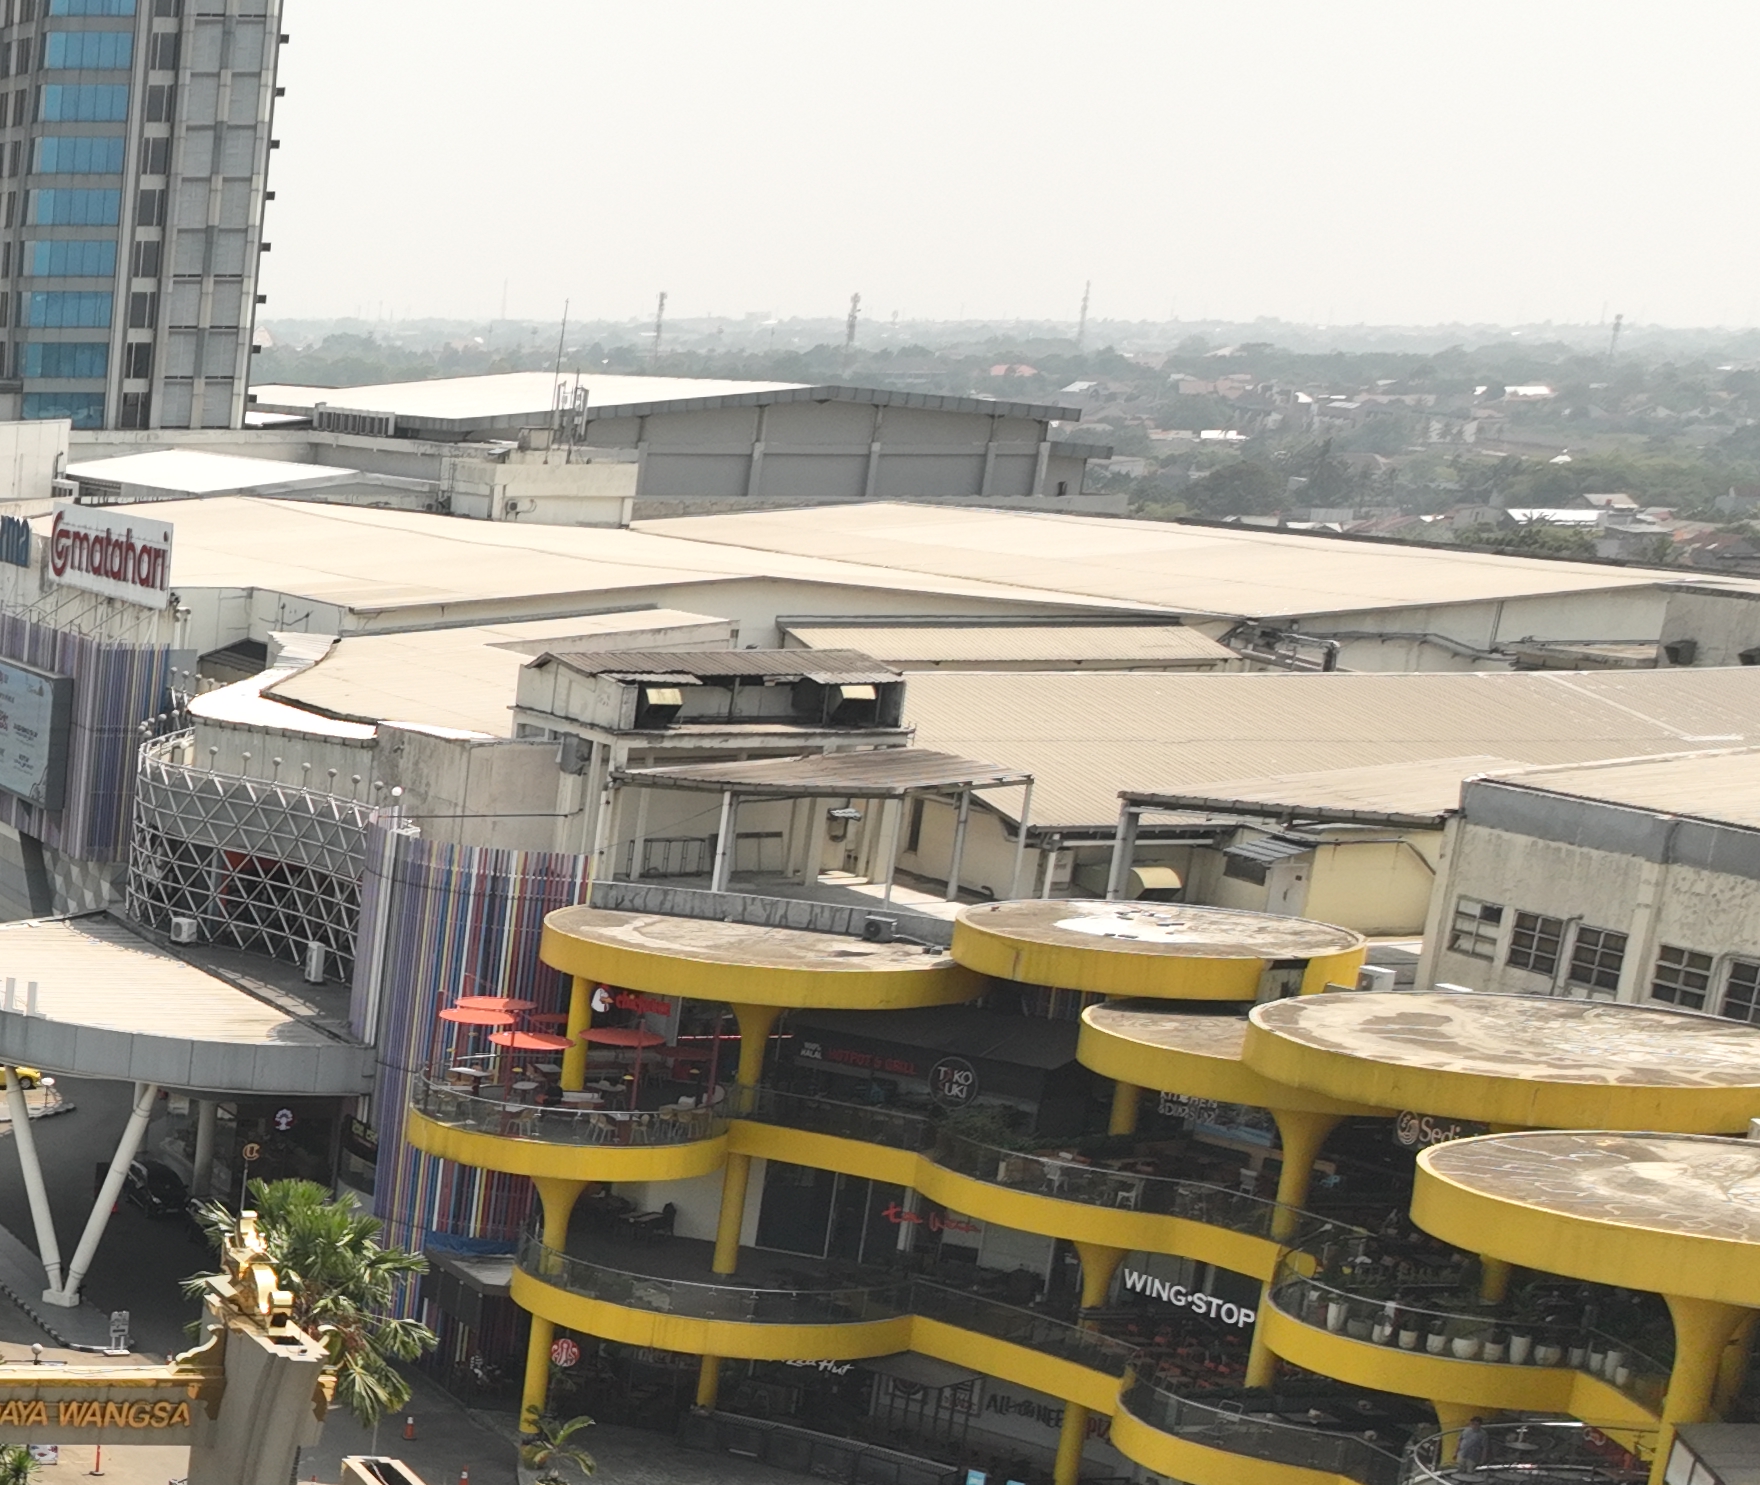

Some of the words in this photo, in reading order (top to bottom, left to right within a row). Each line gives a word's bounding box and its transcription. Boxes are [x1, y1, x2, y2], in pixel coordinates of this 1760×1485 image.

[70, 527, 170, 590] matahari
[884, 1057, 917, 1075] GRILL
[58, 1400, 191, 1429] WANGSA
